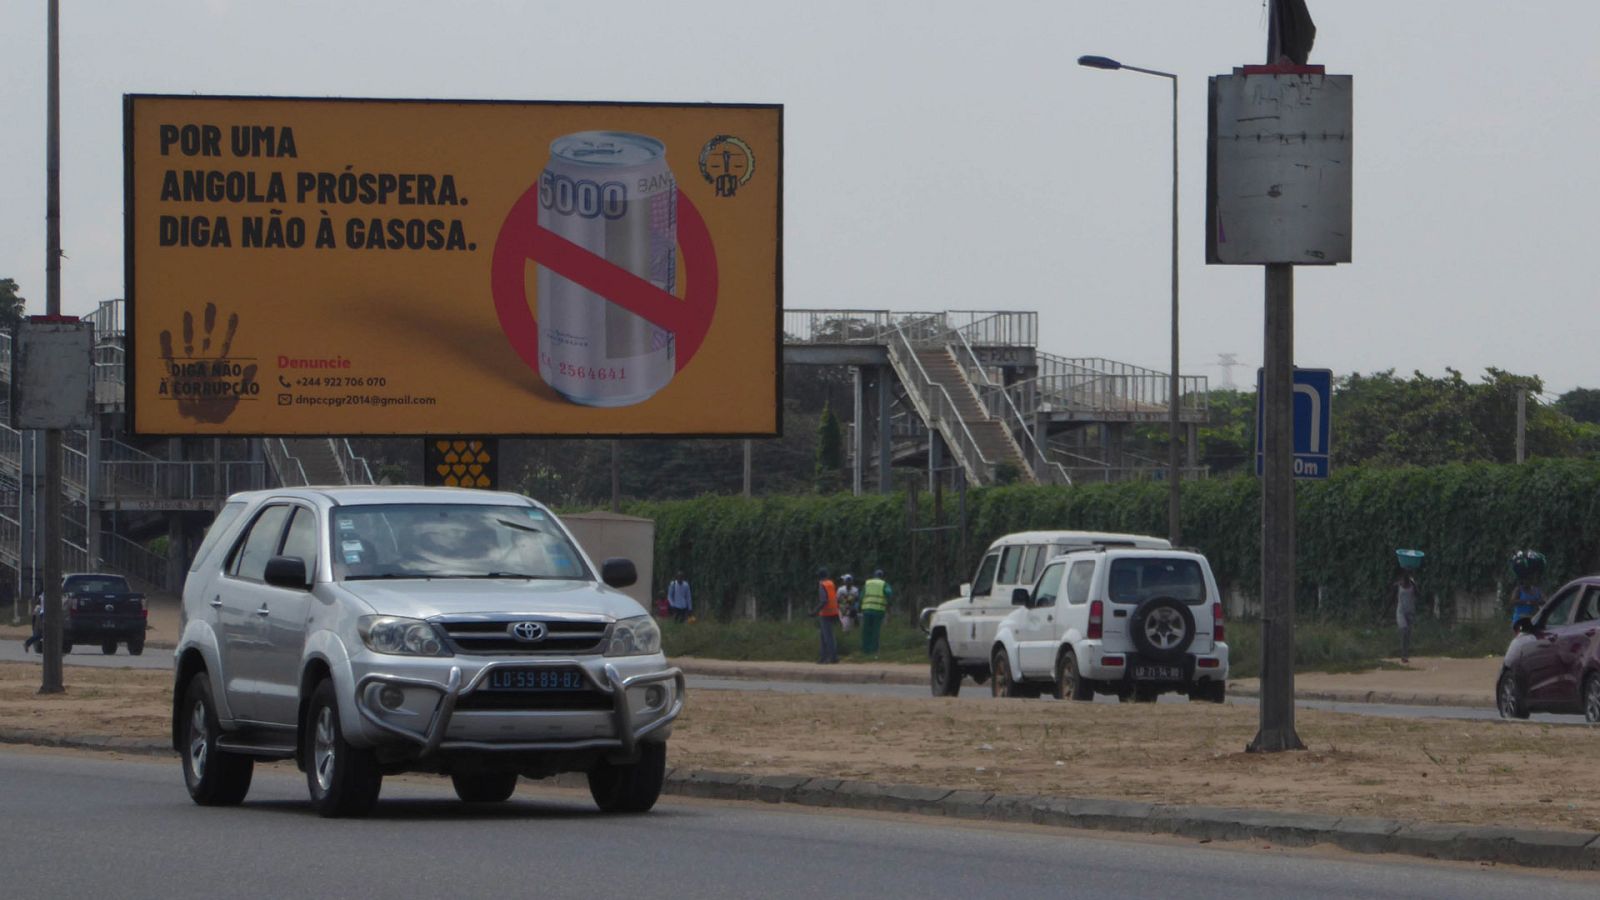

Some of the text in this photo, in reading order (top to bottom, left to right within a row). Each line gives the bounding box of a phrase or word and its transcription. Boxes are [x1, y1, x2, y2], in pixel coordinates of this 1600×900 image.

[159, 124, 298, 158] POR UMA
[160, 165, 469, 206] ANGOLA PRÓSPERA.
[539, 168, 628, 221] 5000
[159, 208, 478, 252] DIGA NÃO À GASOSA.
[171, 361, 242, 377] DIGA NÃO
[278, 355, 351, 370] Denuncie
[559, 362, 626, 381] 2564641
[295, 377, 387, 387] +244 922 706 070
[295, 394, 437, 407] dnpccpgr2014@gmail.com
